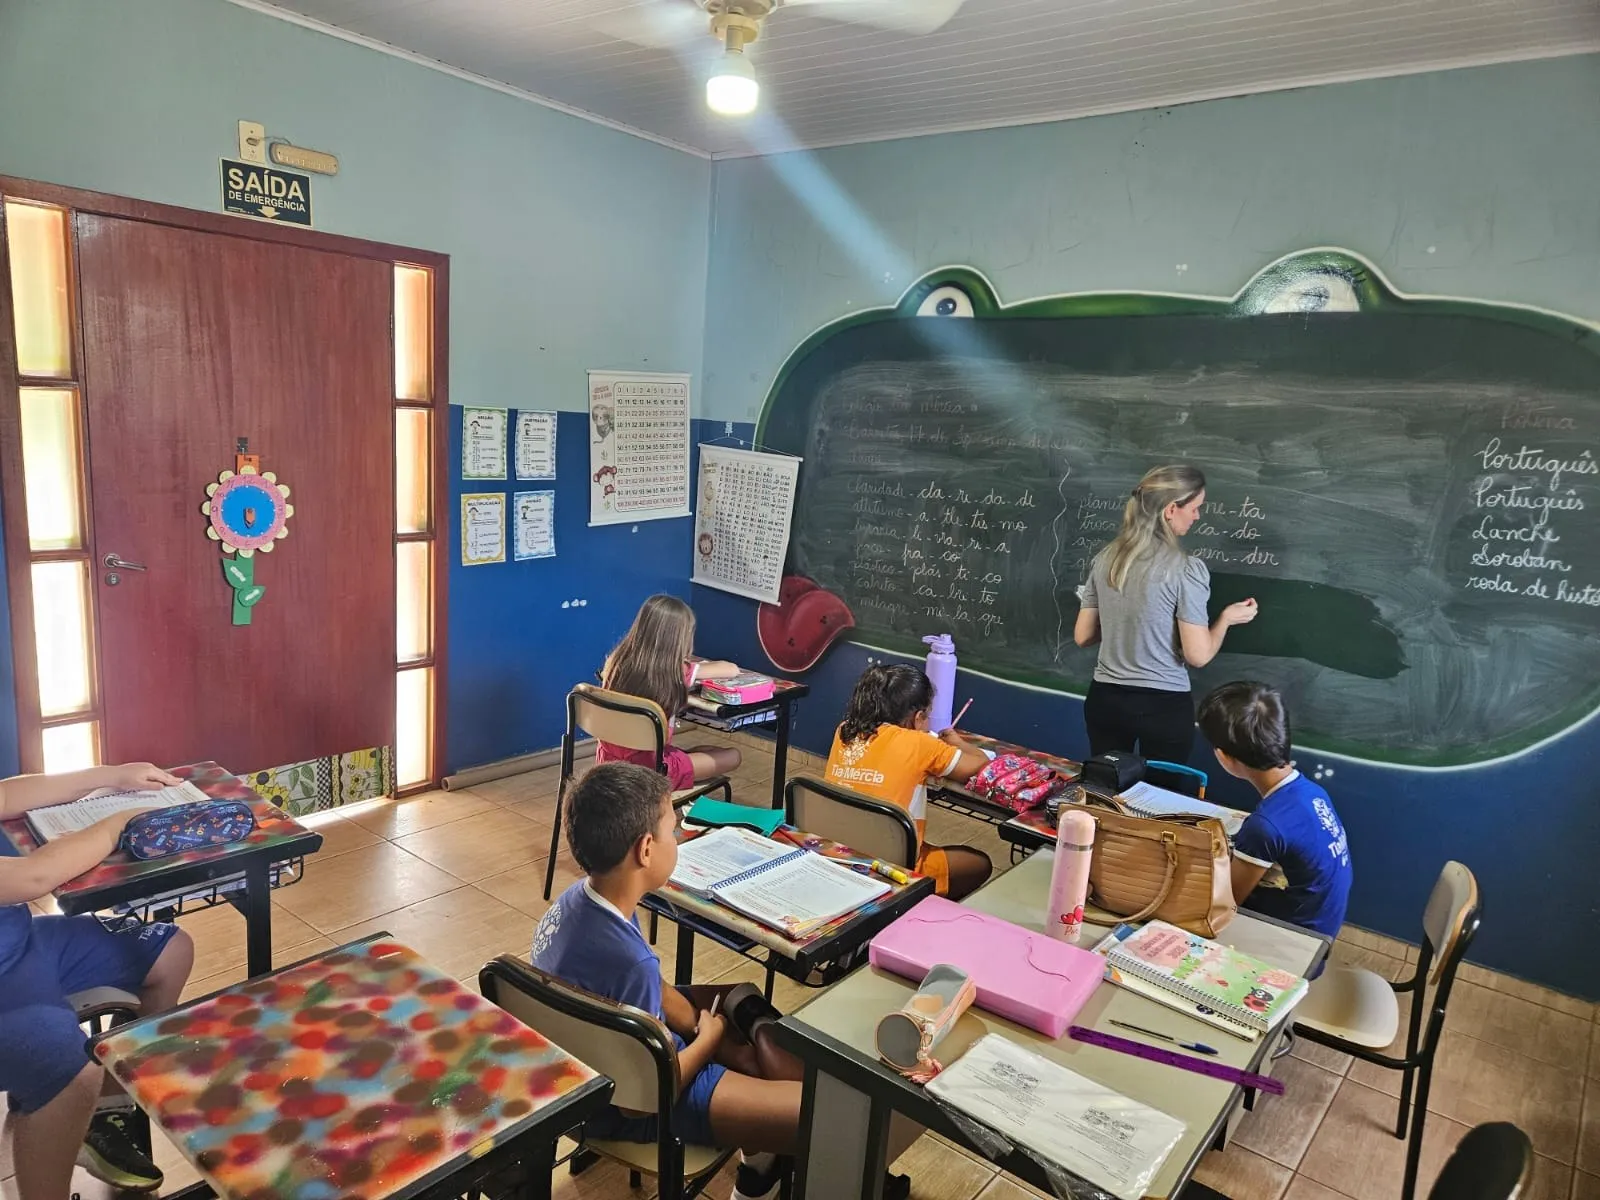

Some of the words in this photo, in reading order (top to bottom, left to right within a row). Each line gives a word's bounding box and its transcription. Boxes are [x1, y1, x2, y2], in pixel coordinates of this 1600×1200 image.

[228, 168, 305, 202] SAÍDA
[228, 190, 242, 201] DE
[244, 193, 306, 212] EMERGÊNCIA
[1473, 437, 1599, 492] Português
[979, 488, 1006, 505] da
[1238, 495, 1266, 520] ta
[1474, 476, 1585, 526] Português
[1230, 521, 1262, 540] do
[1472, 515, 1560, 542] Lanche
[1470, 543, 1572, 572] Soroban
[1465, 574, 1518, 593] roda
[1521, 578, 1550, 599] de
[832, 764, 844, 777] Tia
